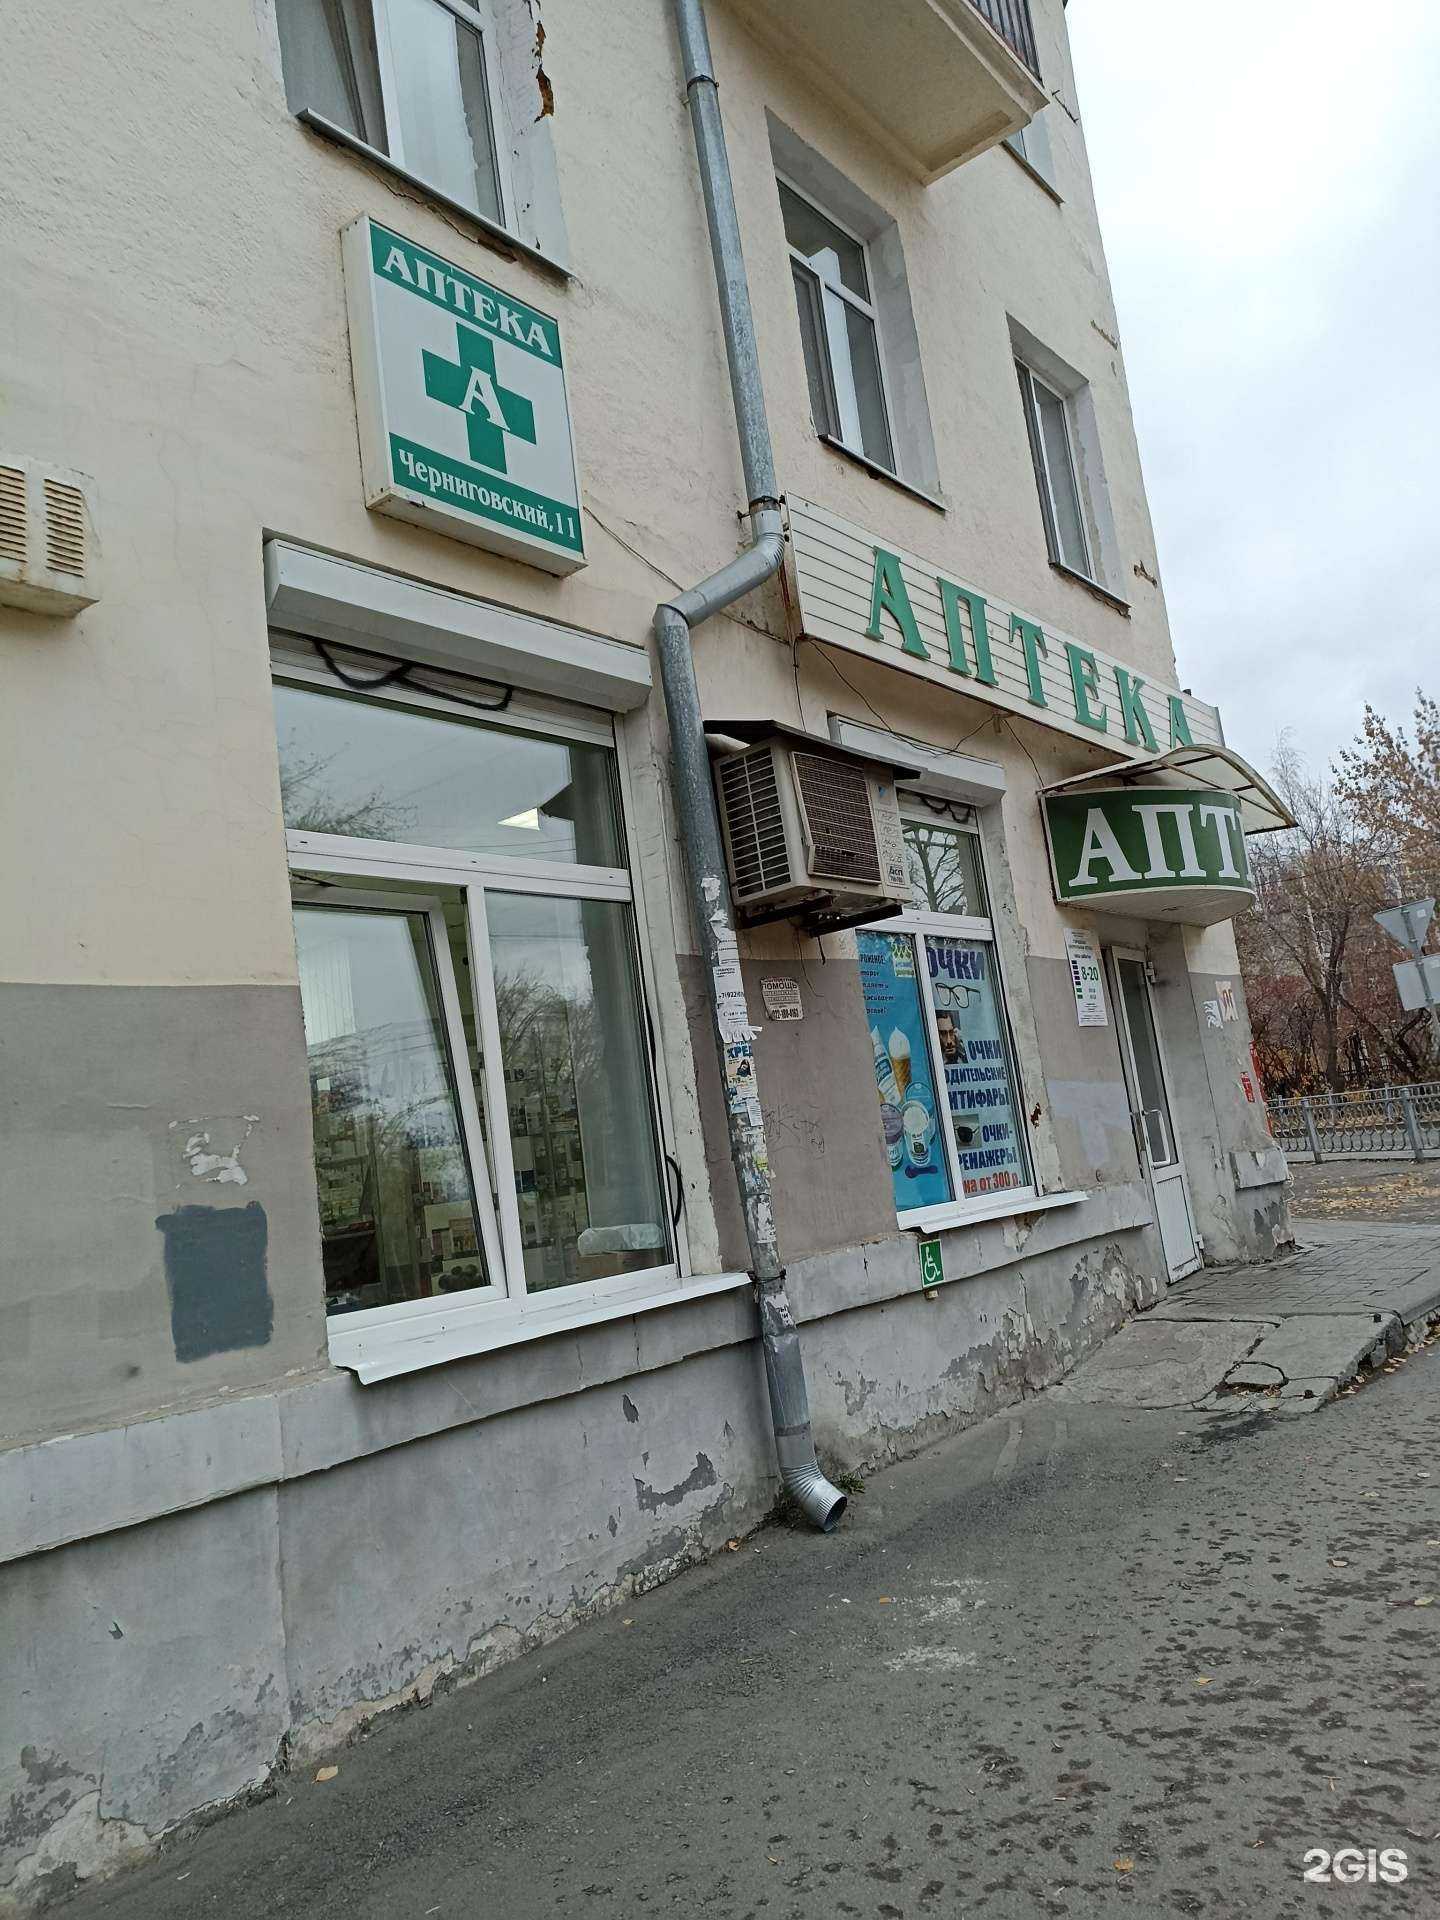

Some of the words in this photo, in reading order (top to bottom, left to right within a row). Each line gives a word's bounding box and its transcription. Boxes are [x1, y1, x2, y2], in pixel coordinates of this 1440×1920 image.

[382, 246, 554, 357] АПТЕКА
[458, 365, 511, 432] А
[865, 545, 1194, 755] АПТЕКА
[1068, 803, 1250, 888] АПТ
[1081, 966, 1099, 982] 8-20
[967, 1039, 1002, 1061] ОЧКИ
[979, 1176, 992, 1191] от
[992, 1170, 1011, 1189] 300
